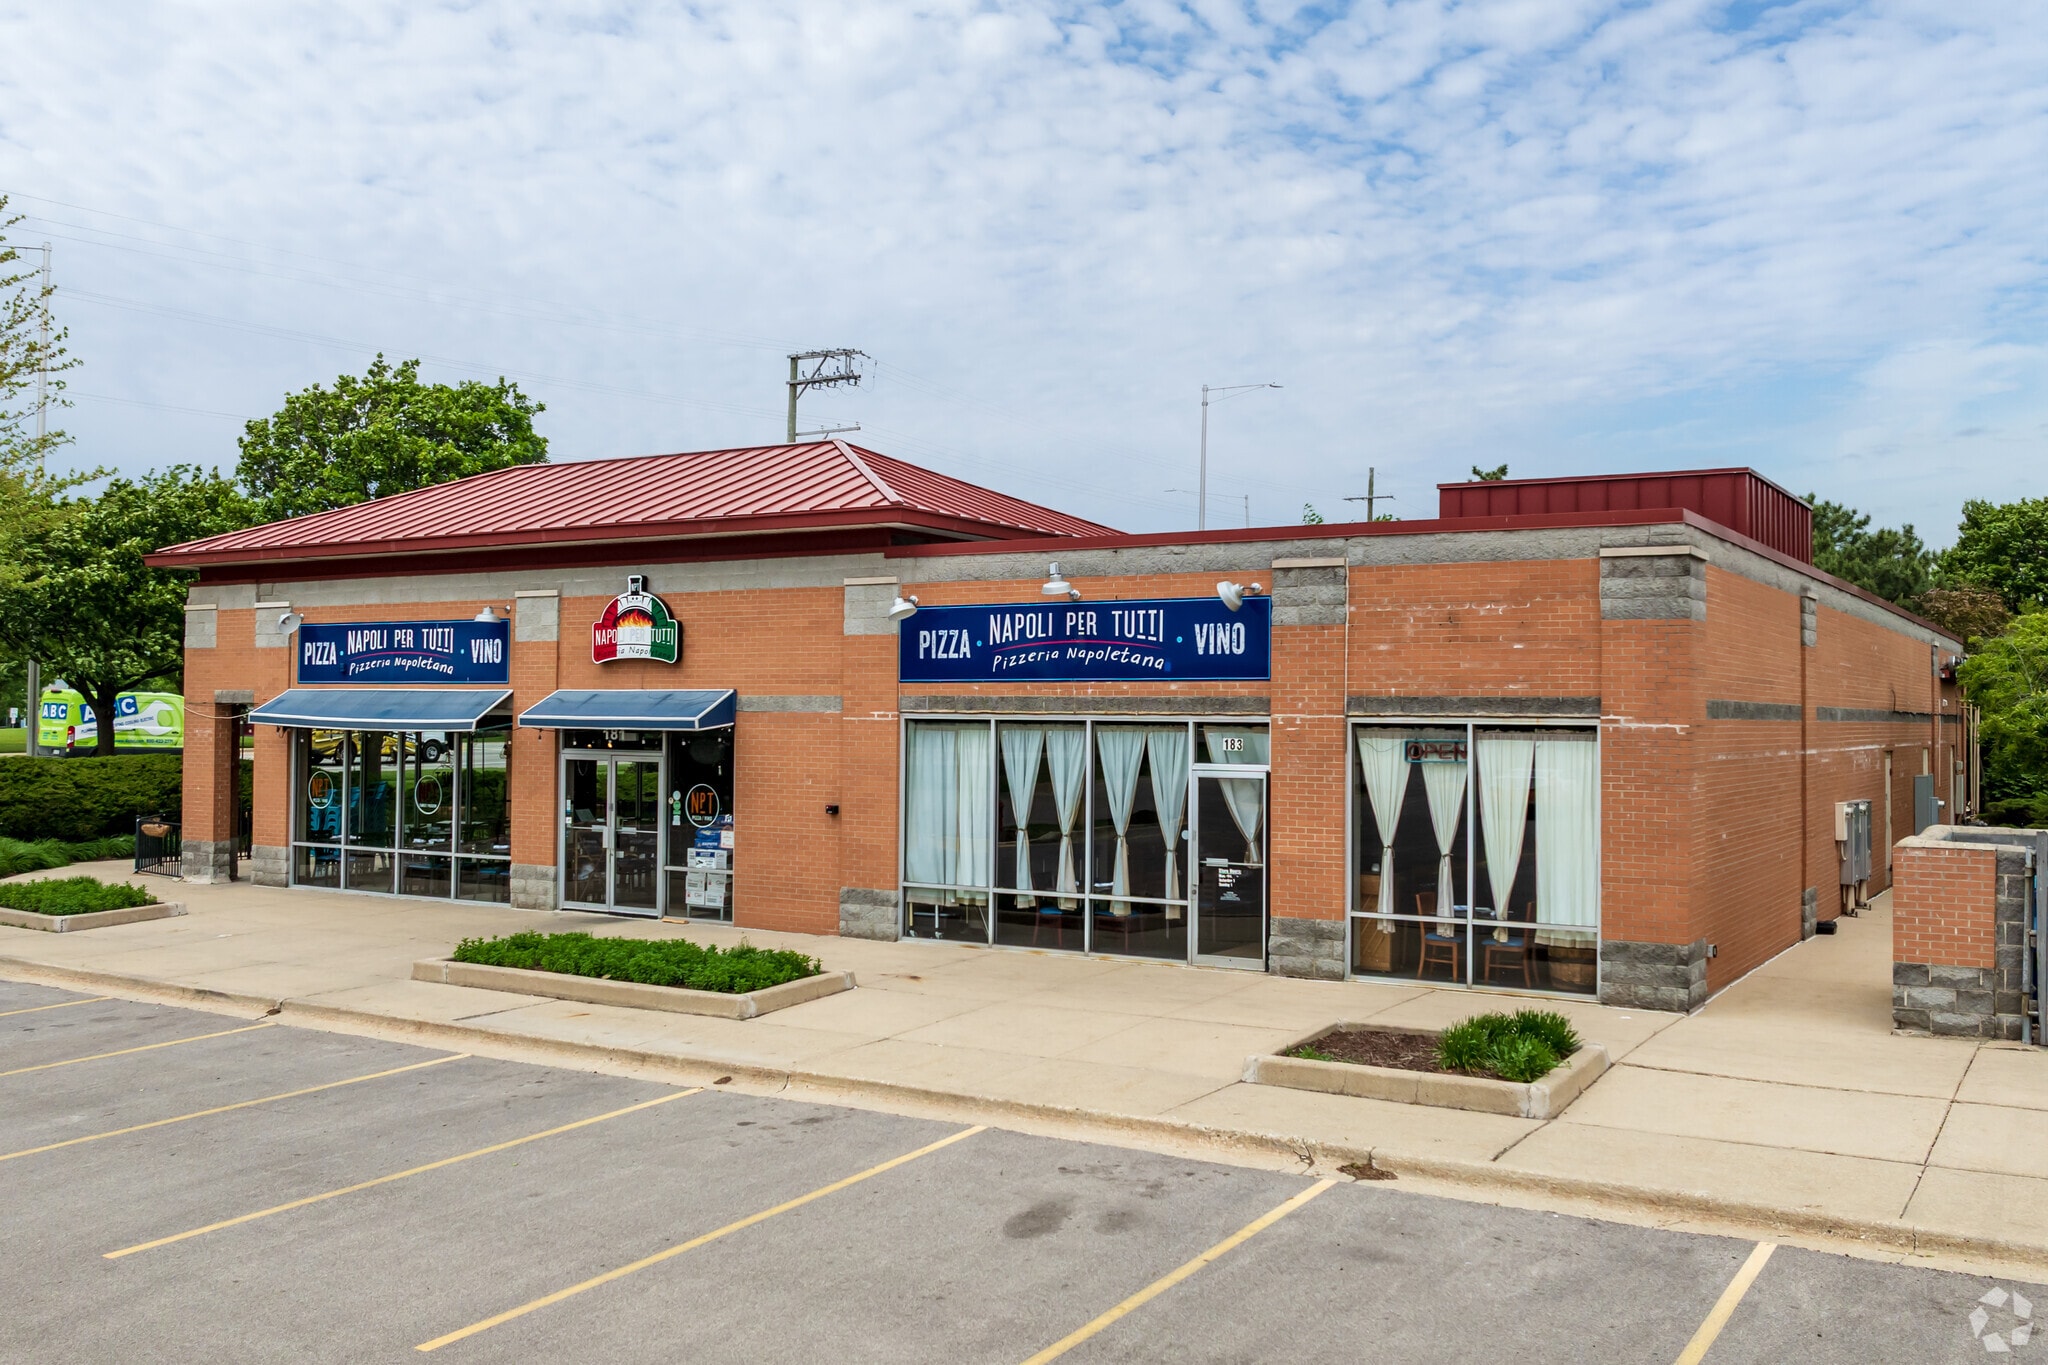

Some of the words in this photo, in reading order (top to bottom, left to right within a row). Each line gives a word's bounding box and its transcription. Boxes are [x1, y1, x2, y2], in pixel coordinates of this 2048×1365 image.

[650, 627, 674, 646] TUTTI
[989, 612, 1053, 646] NAPOLI
[1066, 611, 1098, 636] PER
[1111, 609, 1164, 643] TUTTI
[1194, 622, 1246, 655] VINO
[304, 641, 337, 666] PIZZA
[347, 629, 388, 655] NAPOLI
[394, 628, 414, 648] PER
[422, 627, 454, 654] TUTTI
[470, 638, 502, 664] VINO
[919, 629, 971, 660] PIZZA
[349, 659, 391, 676] Pizzeria
[394, 656, 455, 675] Napoletana
[992, 650, 1060, 673] Pizzeria
[1066, 646, 1165, 671] Napoletana
[42, 704, 67, 718] ABC
[1225, 738, 1243, 751] 183
[1407, 742, 1467, 760] OPEN
[691, 791, 714, 815] NPT
